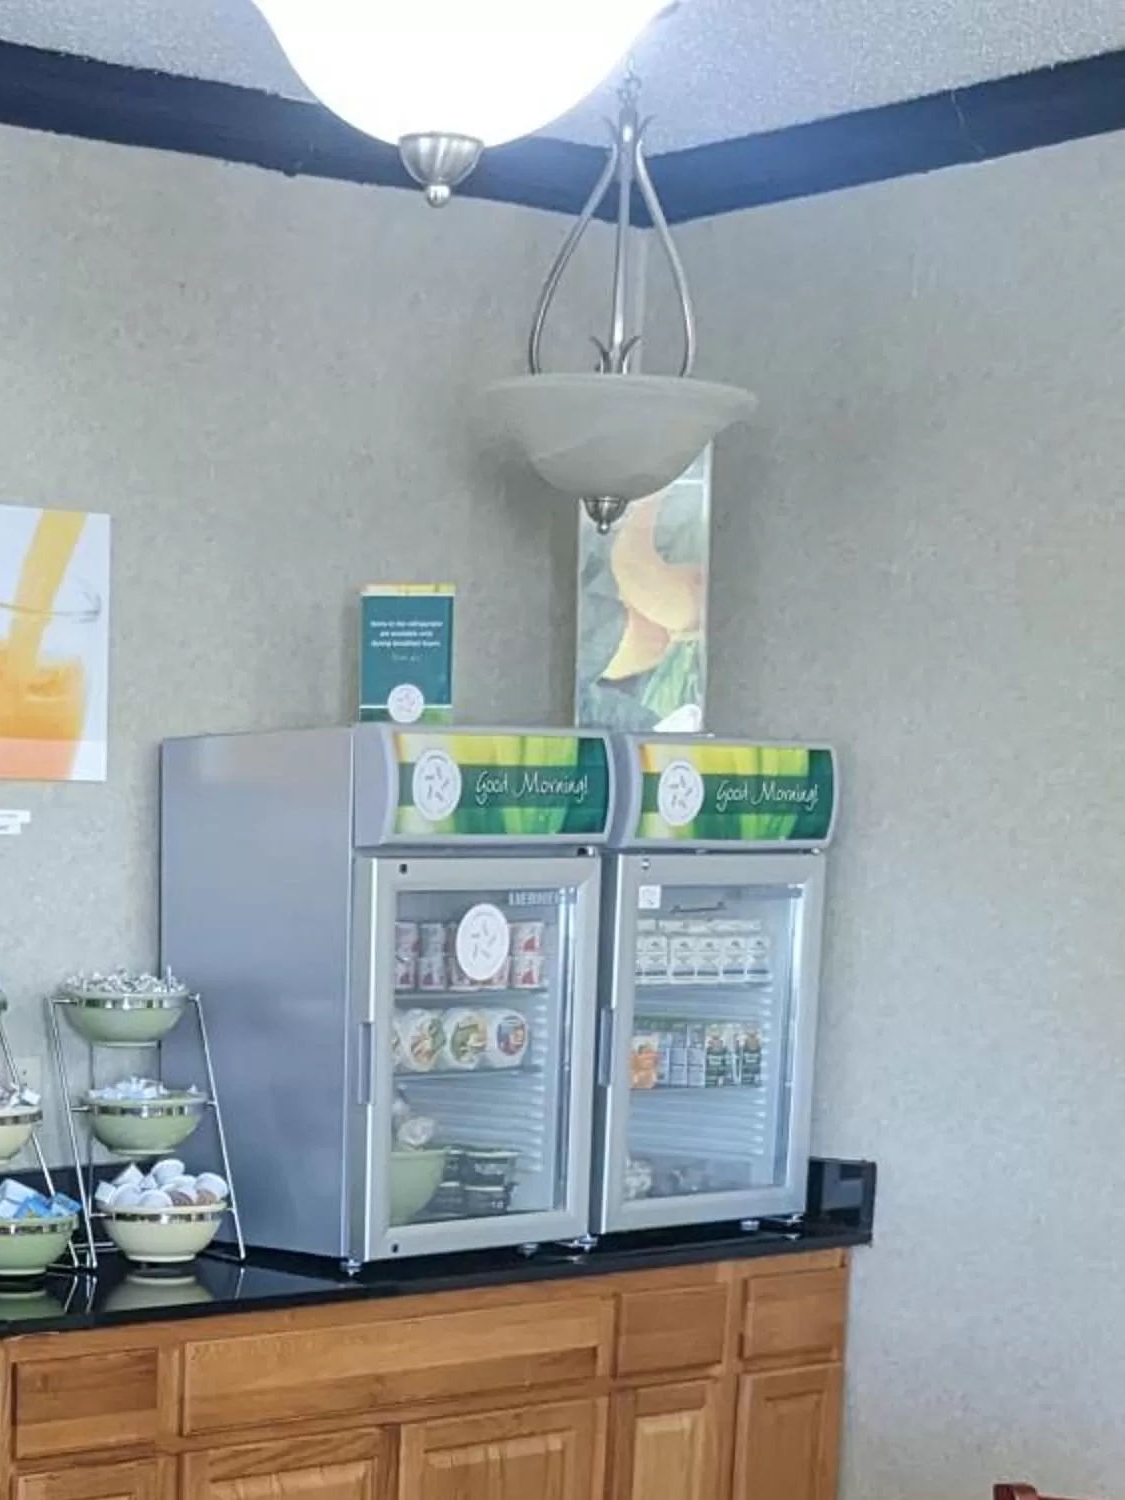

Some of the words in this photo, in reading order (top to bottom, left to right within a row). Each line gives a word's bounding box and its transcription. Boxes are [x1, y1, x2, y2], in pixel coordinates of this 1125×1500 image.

[476, 771, 509, 805] Good
[511, 772, 588, 804] Morning!
[716, 780, 748, 812] Good
[751, 780, 820, 811] Morning!
